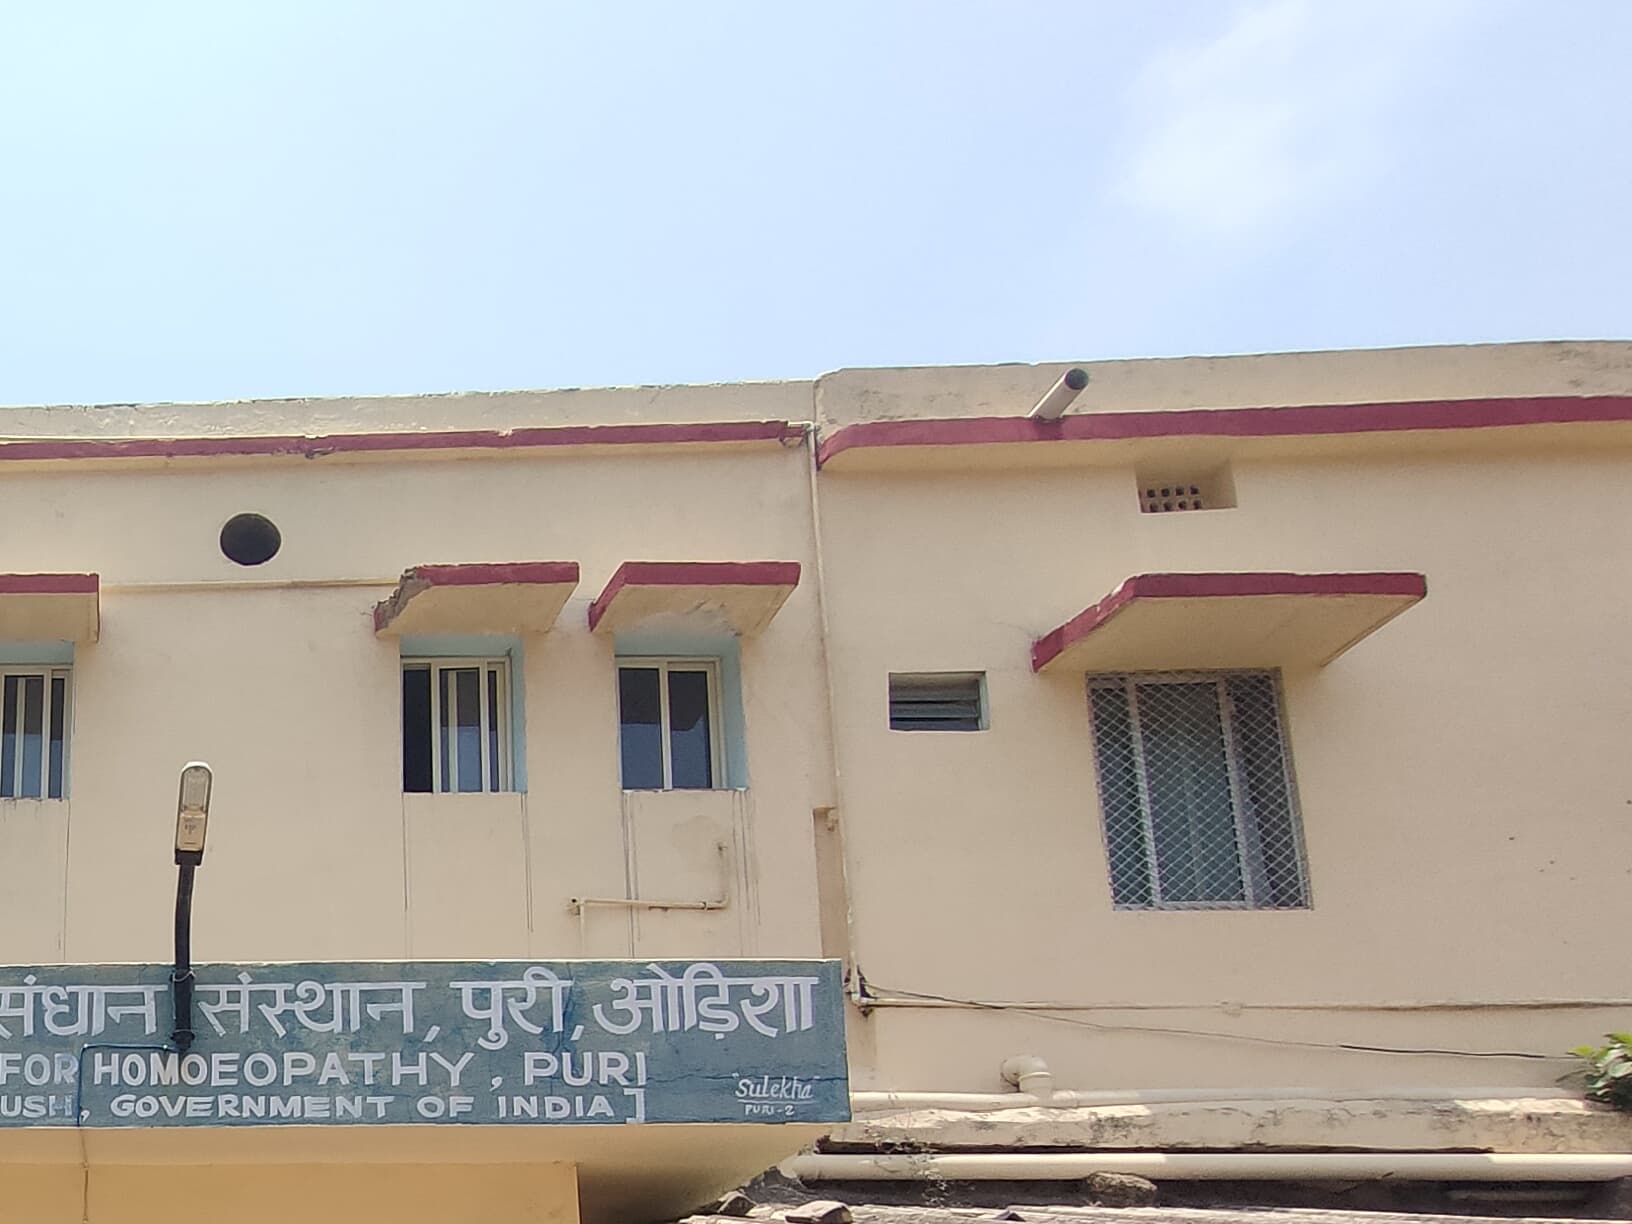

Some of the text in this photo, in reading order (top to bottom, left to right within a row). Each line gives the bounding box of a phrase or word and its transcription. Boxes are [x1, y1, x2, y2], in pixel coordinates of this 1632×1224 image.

[523, 1050, 648, 1087] PURI
[110, 1094, 395, 1118] GOVERNMENT
[417, 1095, 475, 1118] OF
